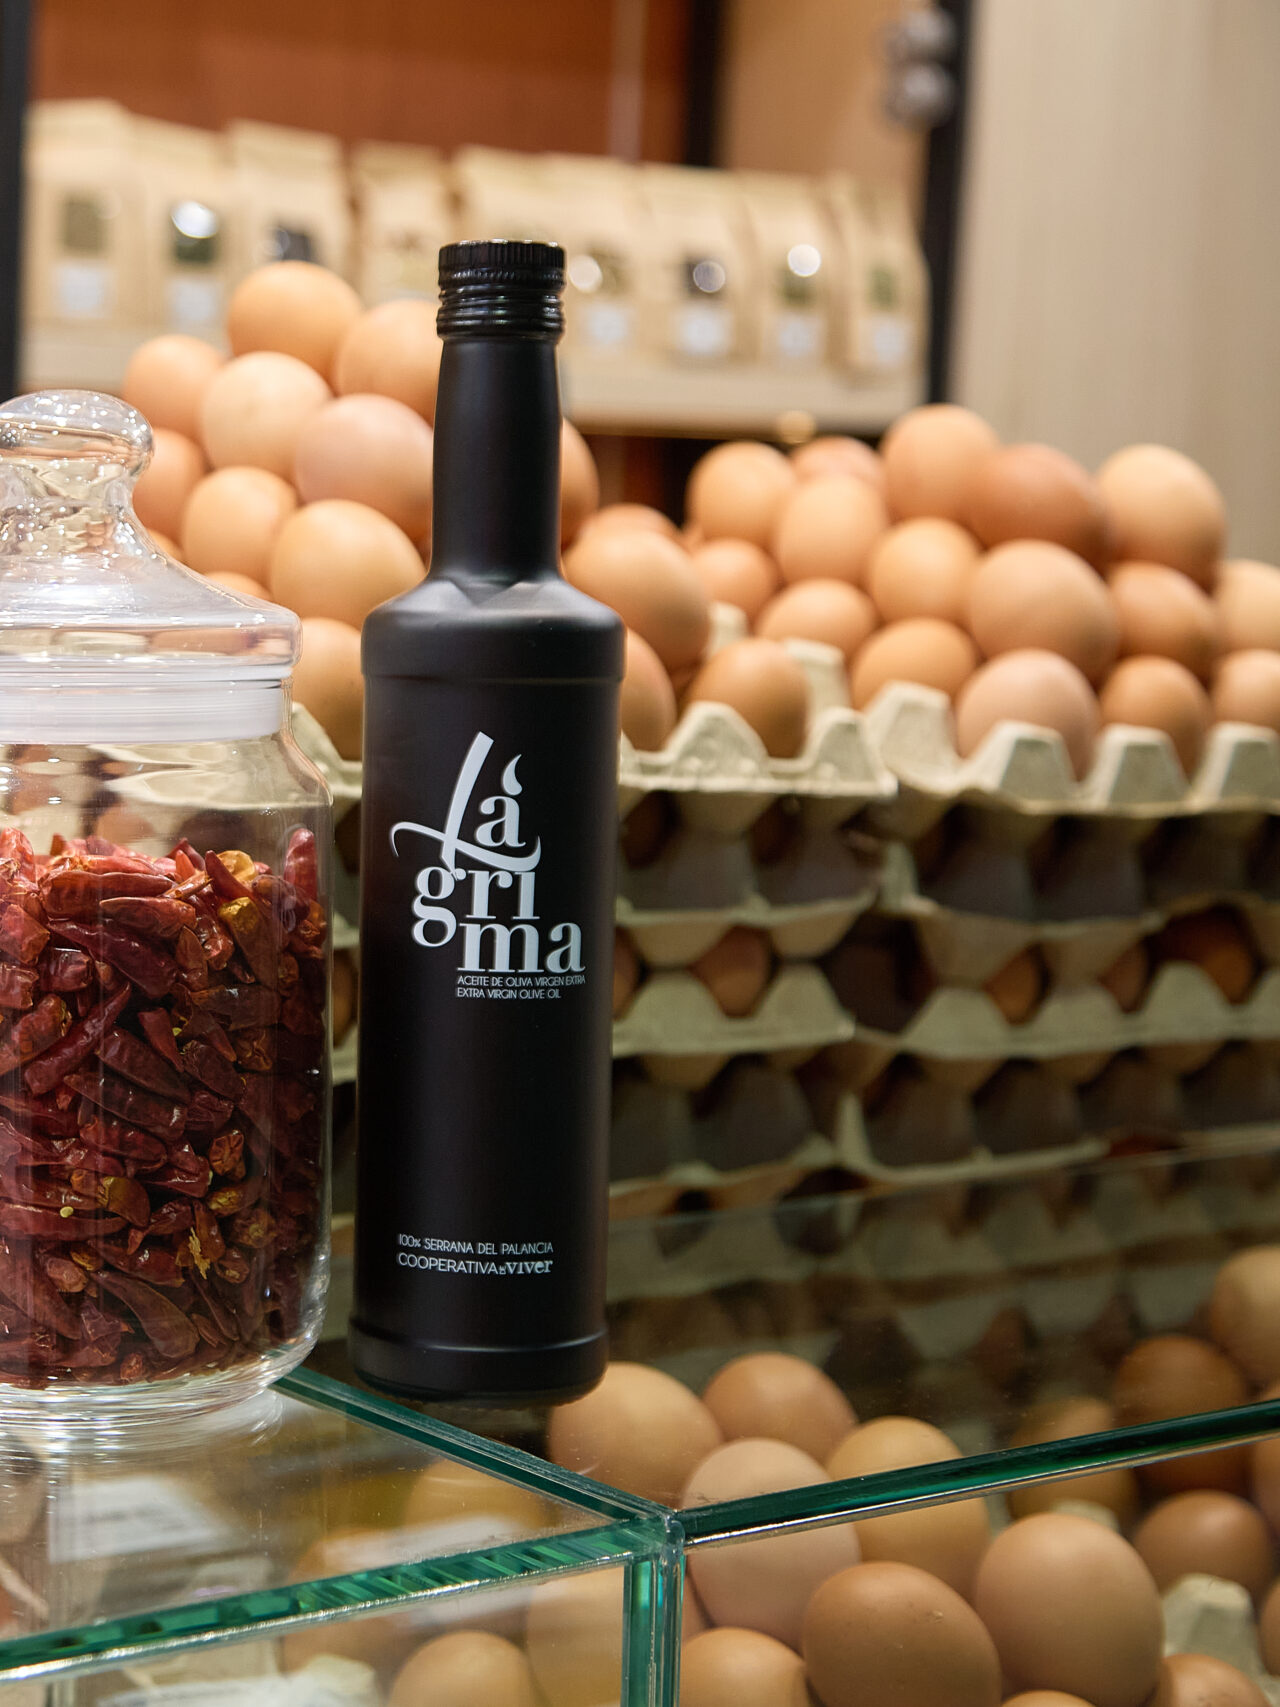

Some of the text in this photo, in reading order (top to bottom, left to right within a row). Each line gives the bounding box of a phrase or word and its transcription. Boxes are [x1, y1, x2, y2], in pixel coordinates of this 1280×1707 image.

[457, 975, 489, 986] ACEITE
[491, 976, 503, 987] DE
[505, 976, 533, 987] OLIVA
[534, 976, 564, 987] VIRGEN
[457, 987, 561, 999] EXTRA VIRGIN OLIVE OIL
[398, 1233, 554, 1255] 100% SERRANA DEL PALANCIA
[397, 1252, 499, 1275] COOPERATIVA
[506, 1260, 554, 1275] viver
